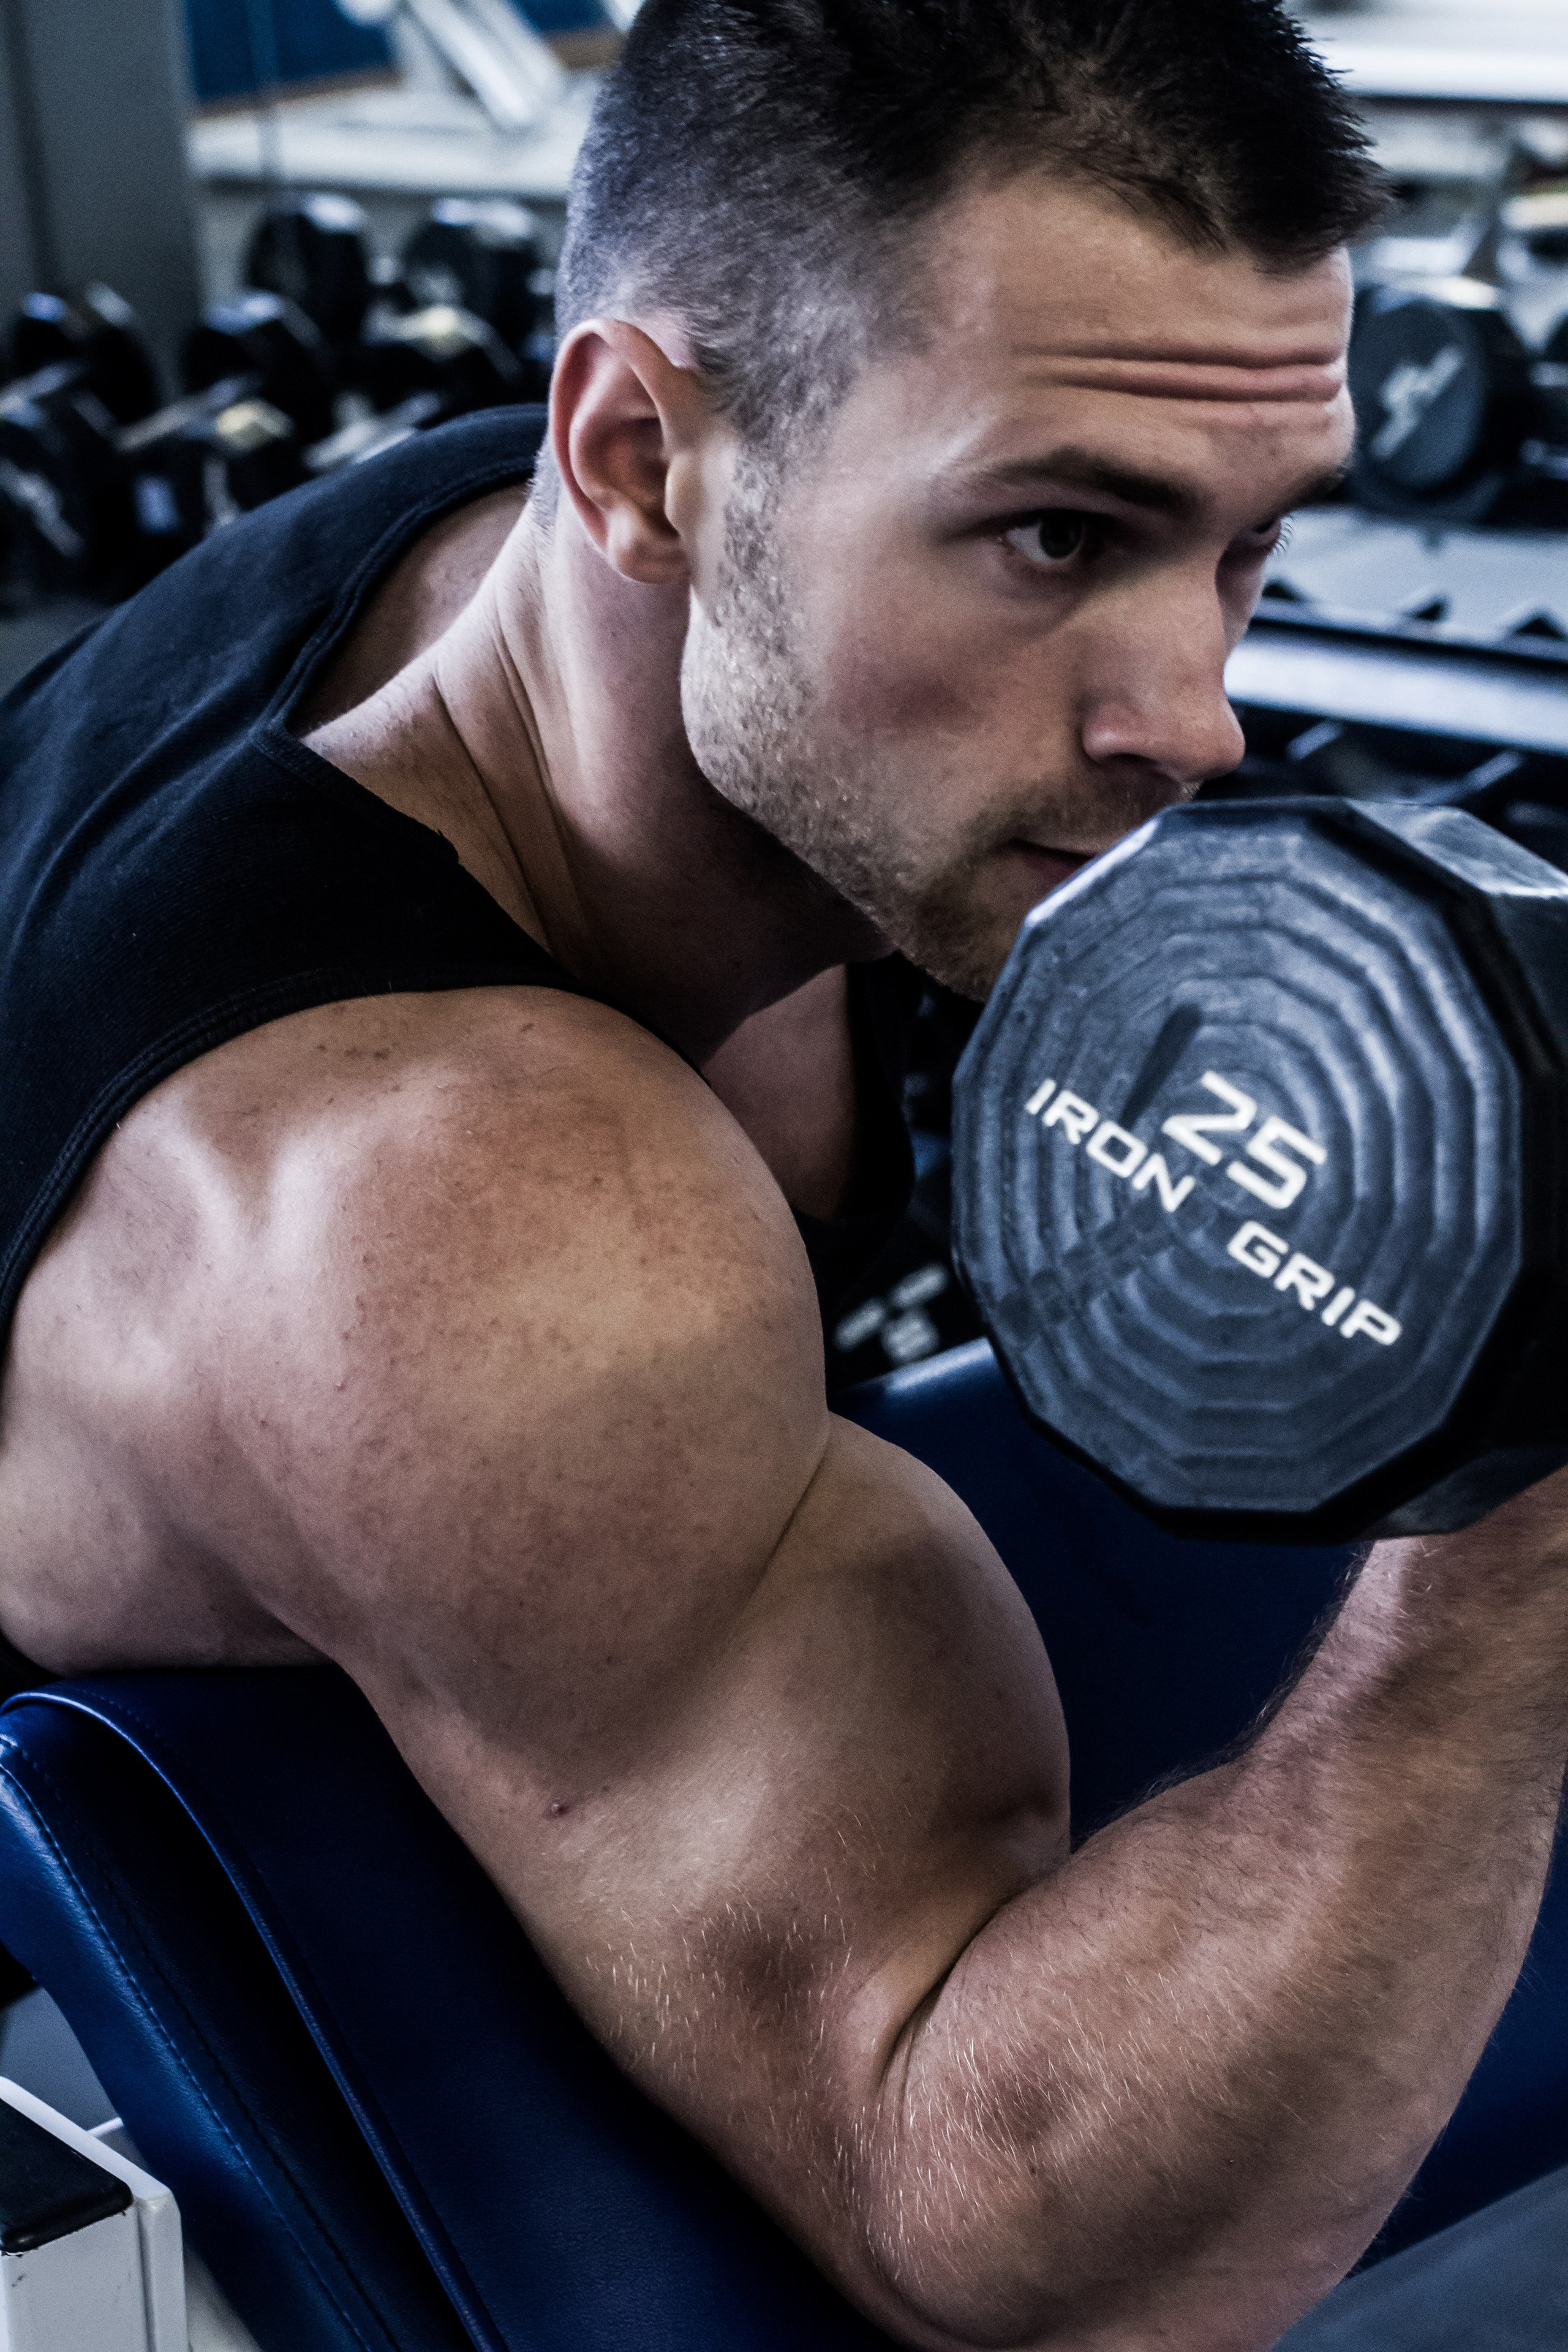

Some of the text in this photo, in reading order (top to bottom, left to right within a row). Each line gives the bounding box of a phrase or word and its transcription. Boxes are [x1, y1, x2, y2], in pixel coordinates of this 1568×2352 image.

[1025, 1078, 1402, 1346] IRON GRIP
[1163, 1069, 1328, 1210] 25
